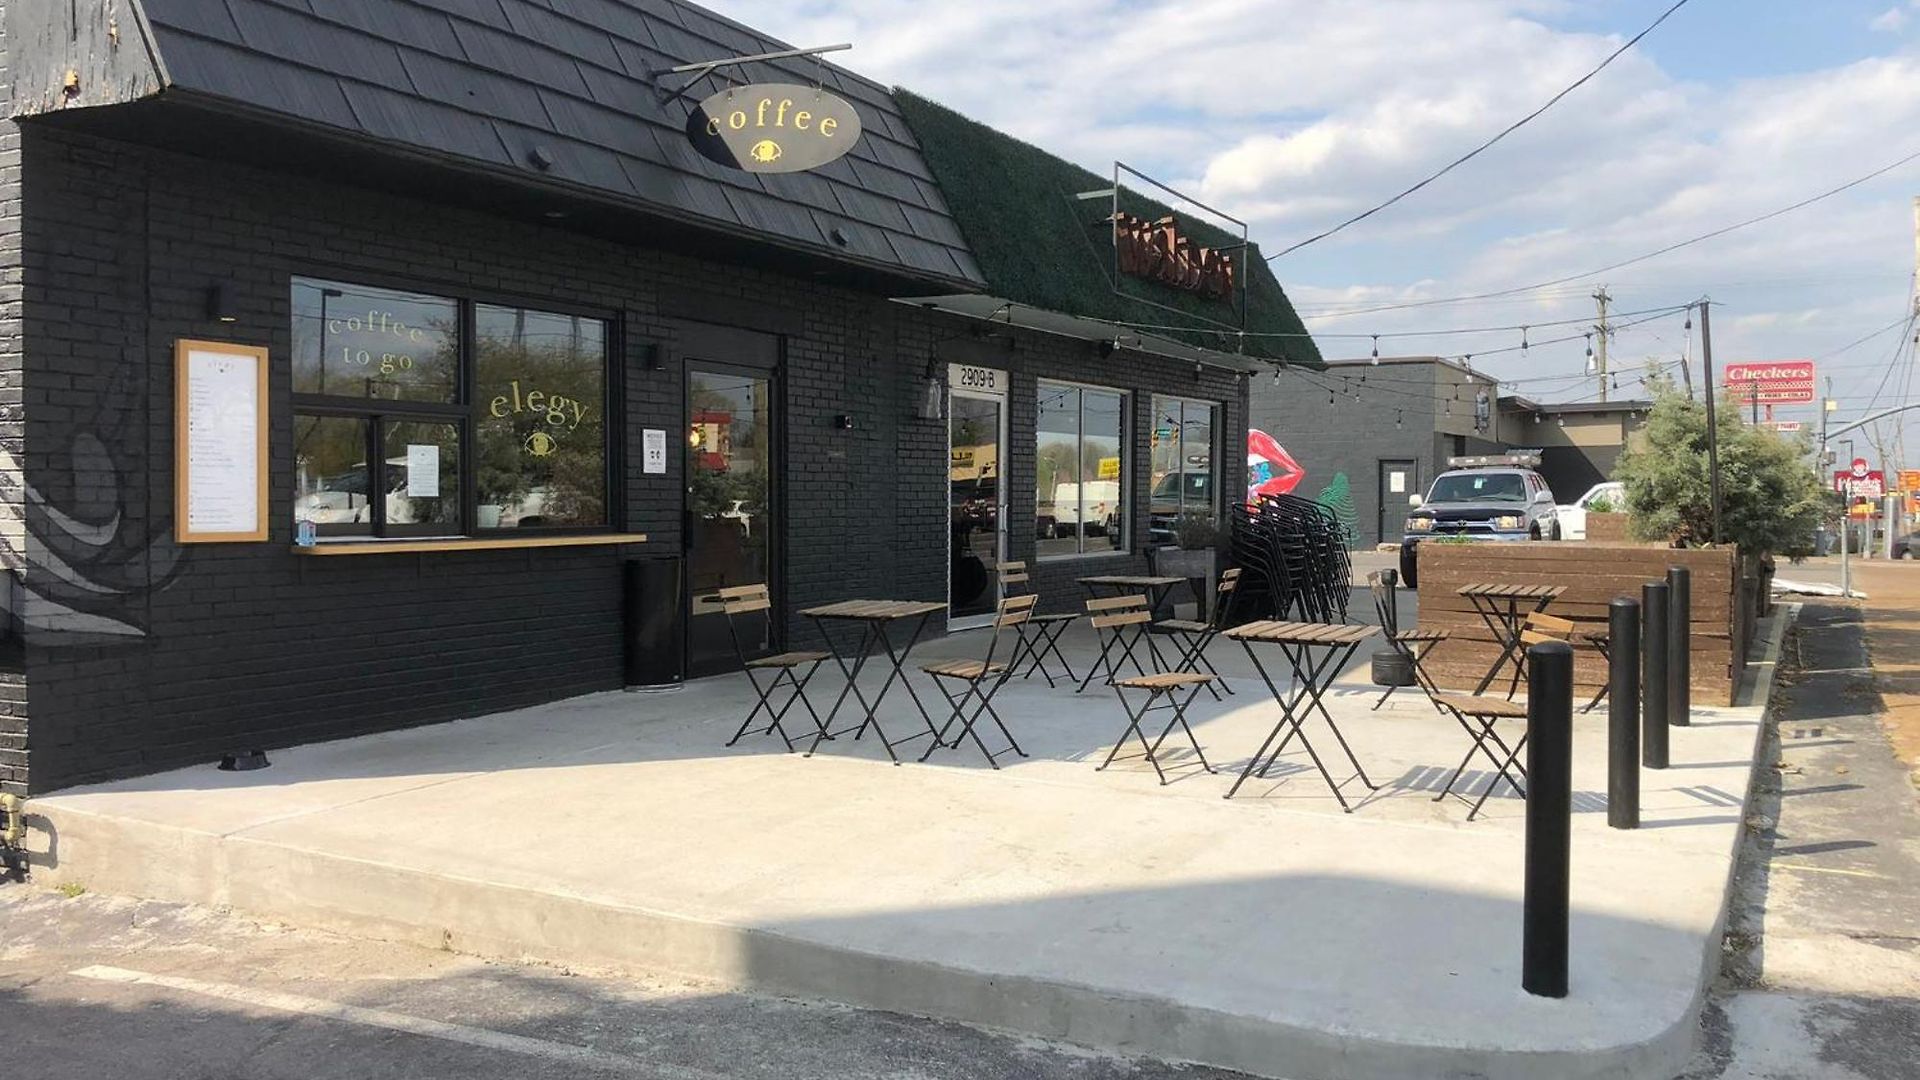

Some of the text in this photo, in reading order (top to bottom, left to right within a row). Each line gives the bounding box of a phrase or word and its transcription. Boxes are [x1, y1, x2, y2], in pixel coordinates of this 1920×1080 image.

[706, 98, 838, 137] coffee
[329, 310, 424, 343] coffee
[343, 347, 413, 375] to go
[1729, 367, 1809, 380] Checkers
[961, 368, 995, 388] 2909-B
[490, 380, 590, 435] elegy
